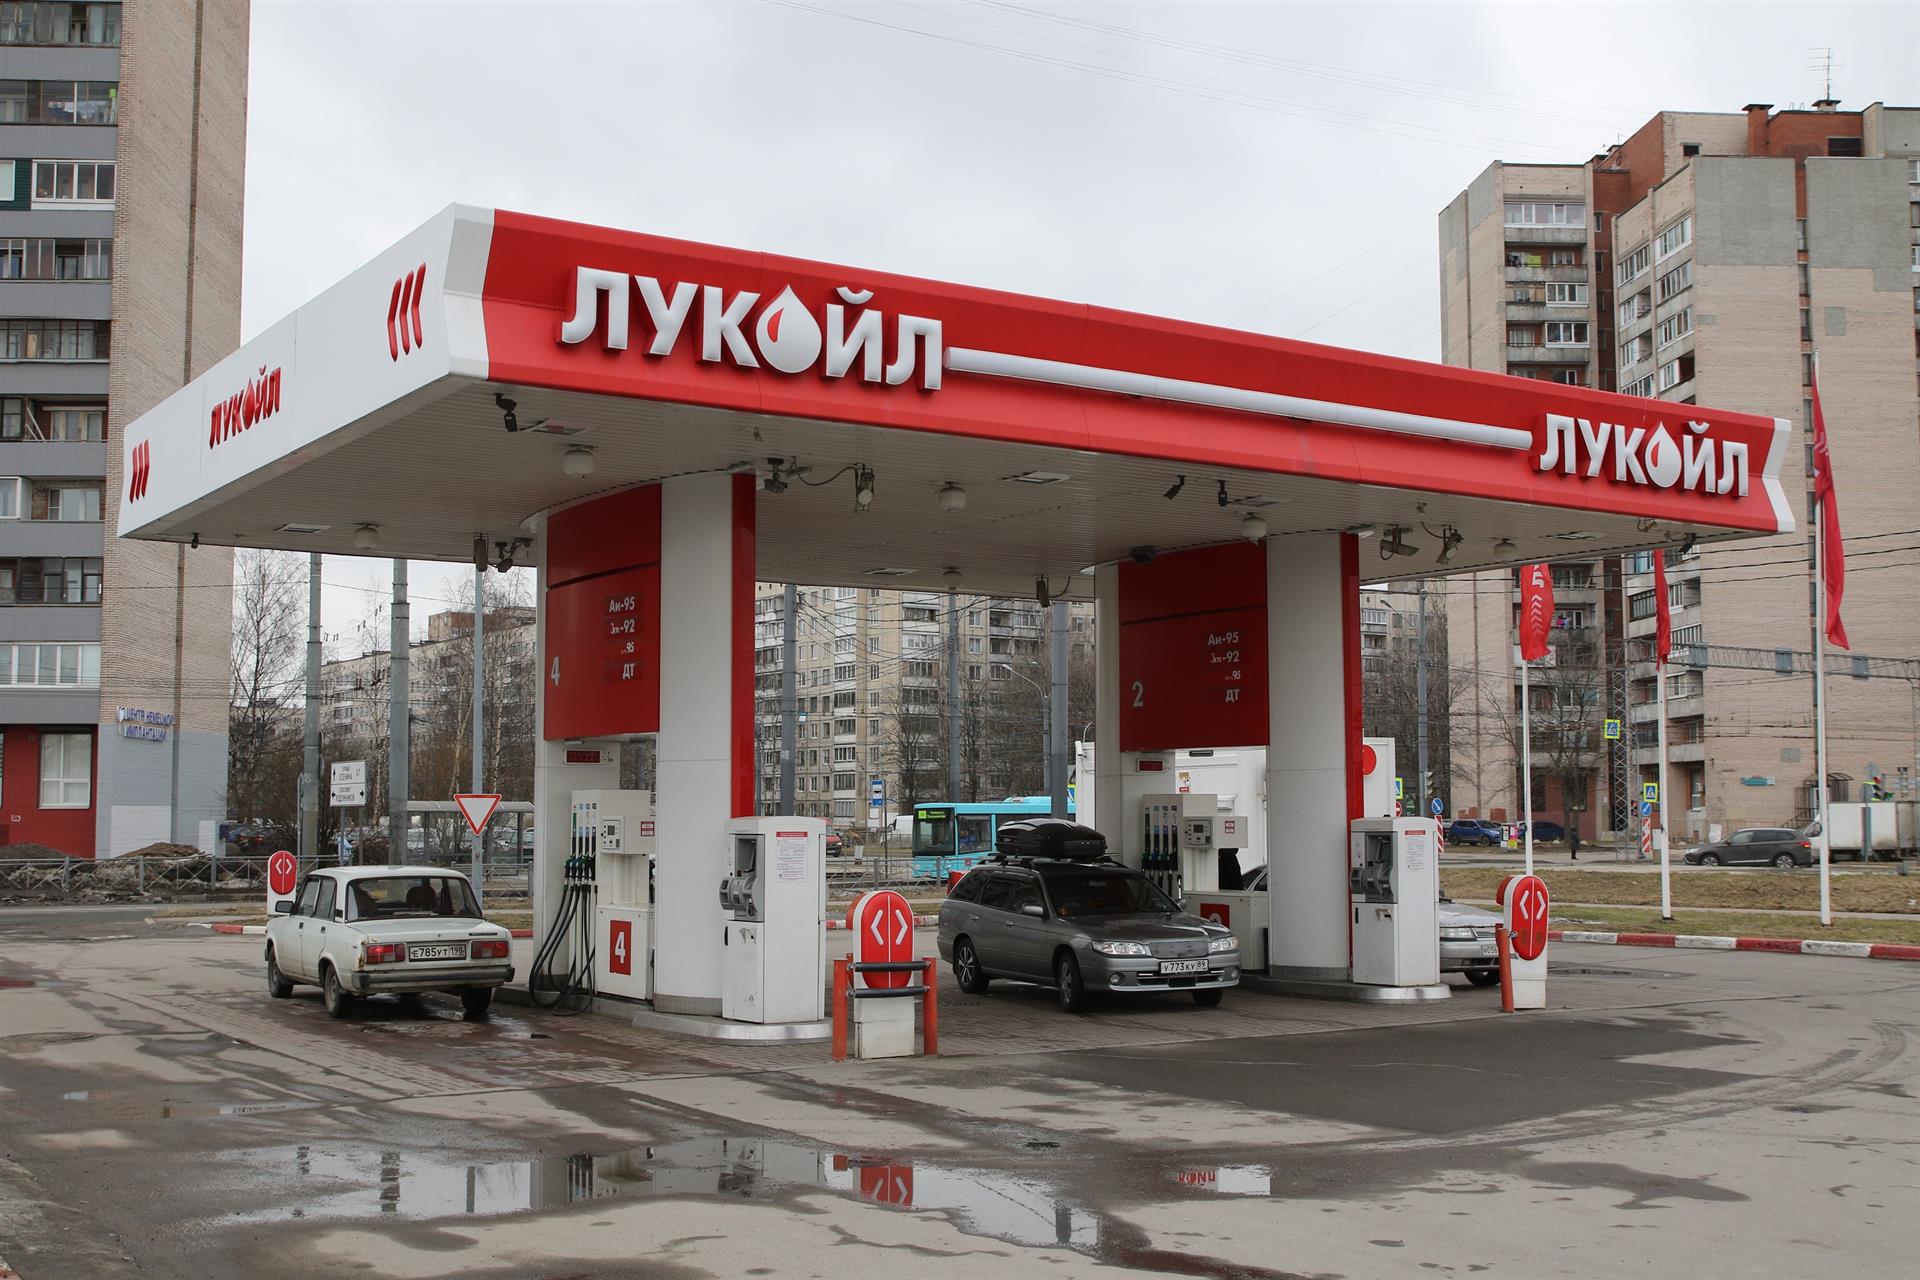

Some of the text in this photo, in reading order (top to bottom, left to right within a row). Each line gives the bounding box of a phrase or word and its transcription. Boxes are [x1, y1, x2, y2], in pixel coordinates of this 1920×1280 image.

[560, 265, 943, 391] ЛУКОЙЛ
[209, 364, 282, 450] ЛУКОЙЛ
[1539, 413, 1750, 497] ЛУКОЙЛ
[550, 656, 560, 687] 4
[622, 663, 635, 680] ДТ
[1132, 680, 1144, 708] 2
[1225, 688, 1240, 703] ДТ
[614, 930, 626, 965] 4
